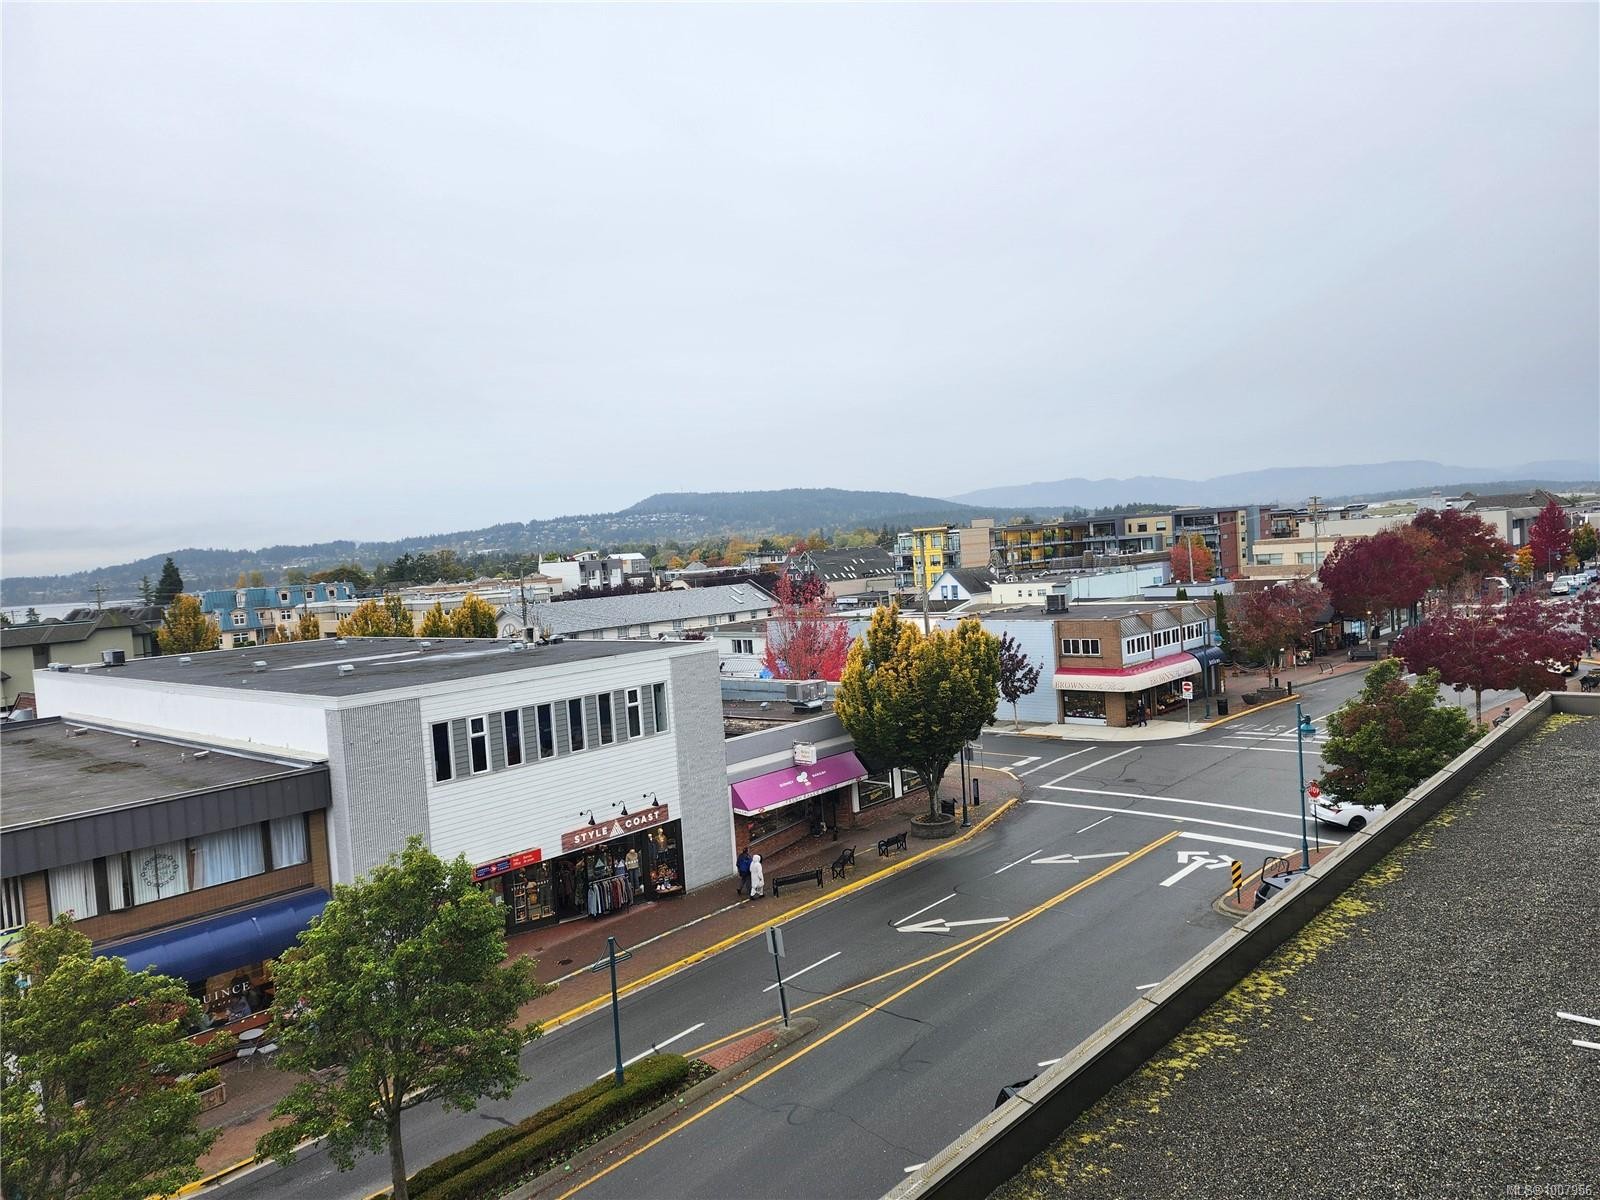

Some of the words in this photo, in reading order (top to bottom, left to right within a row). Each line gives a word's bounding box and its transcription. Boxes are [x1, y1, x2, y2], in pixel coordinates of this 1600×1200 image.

[574, 827, 608, 844] STYLE
[625, 810, 660, 828] COAST
[202, 981, 250, 1004] UINCE
